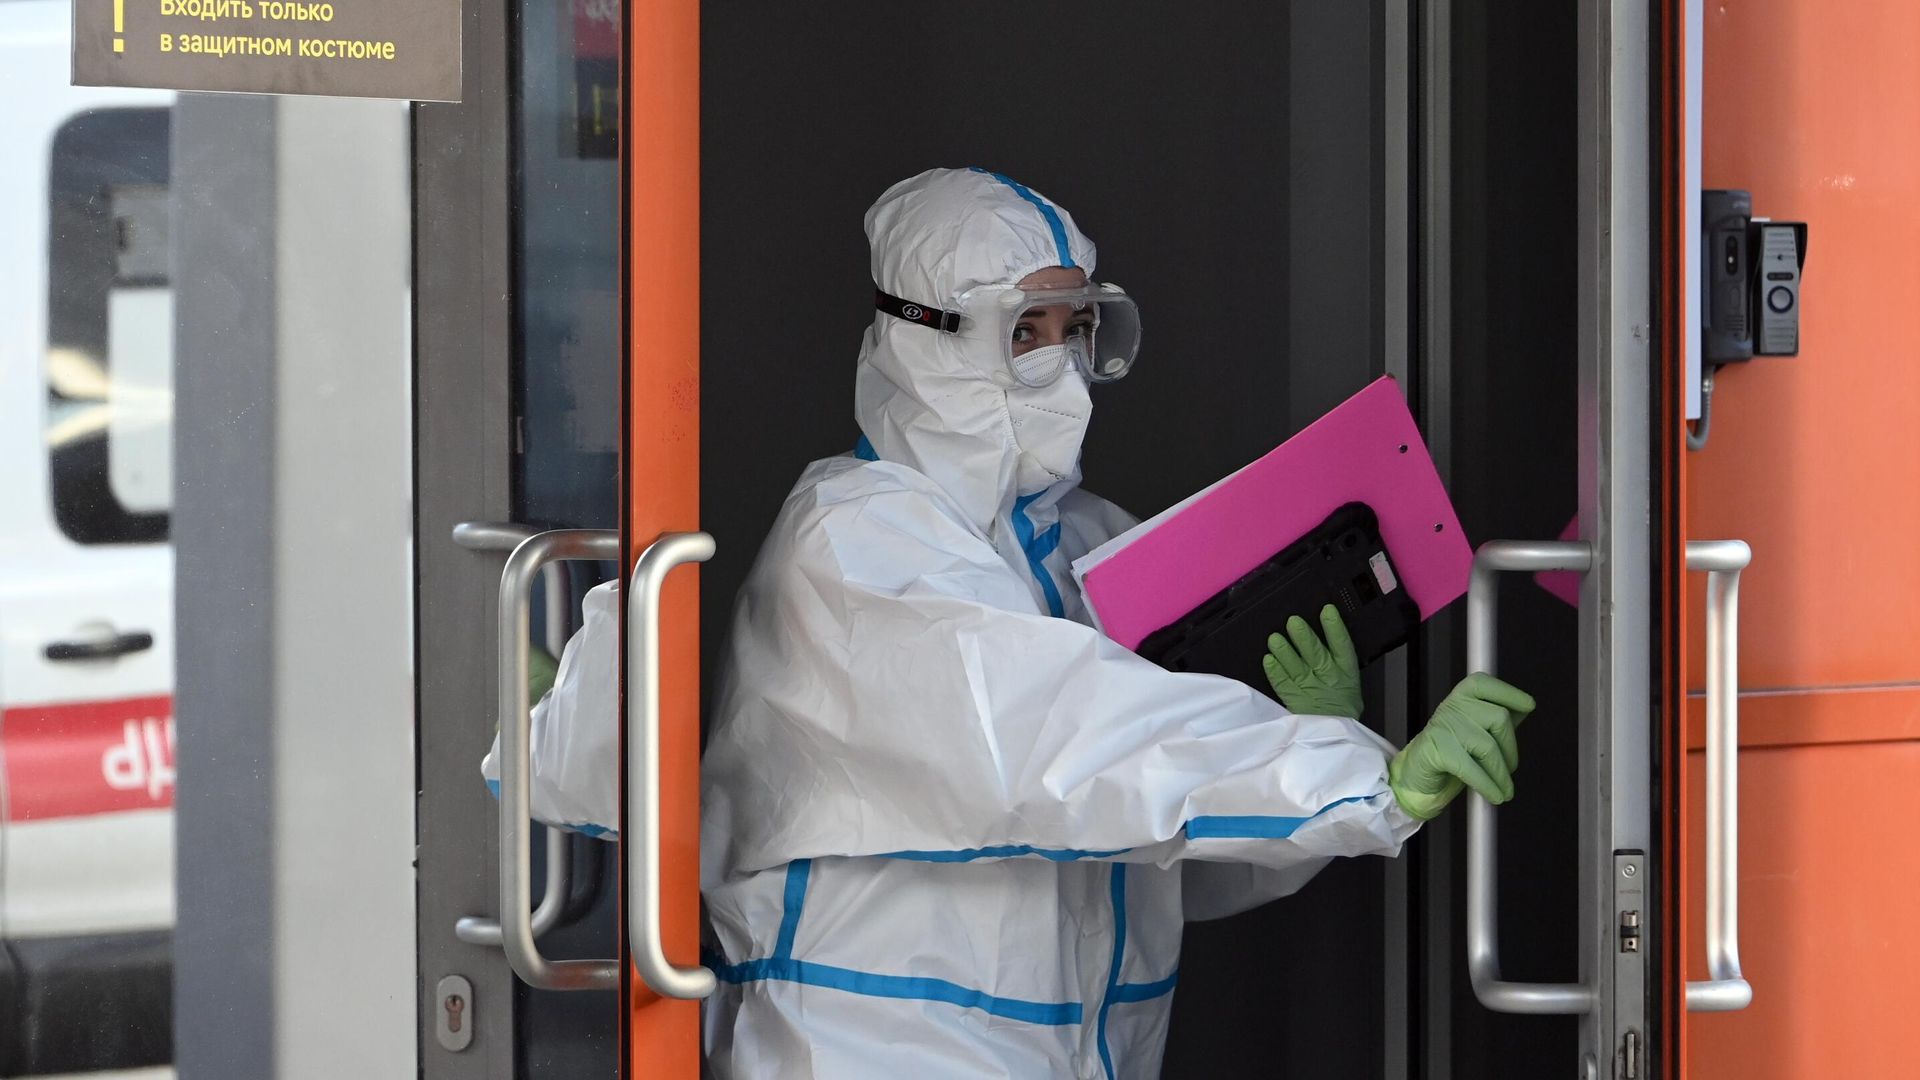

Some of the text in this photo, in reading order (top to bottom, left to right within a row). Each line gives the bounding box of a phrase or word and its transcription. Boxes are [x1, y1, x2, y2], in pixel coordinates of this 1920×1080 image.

[160, 0, 334, 22] Входить только
[160, 33, 395, 60] в защитном костюме
